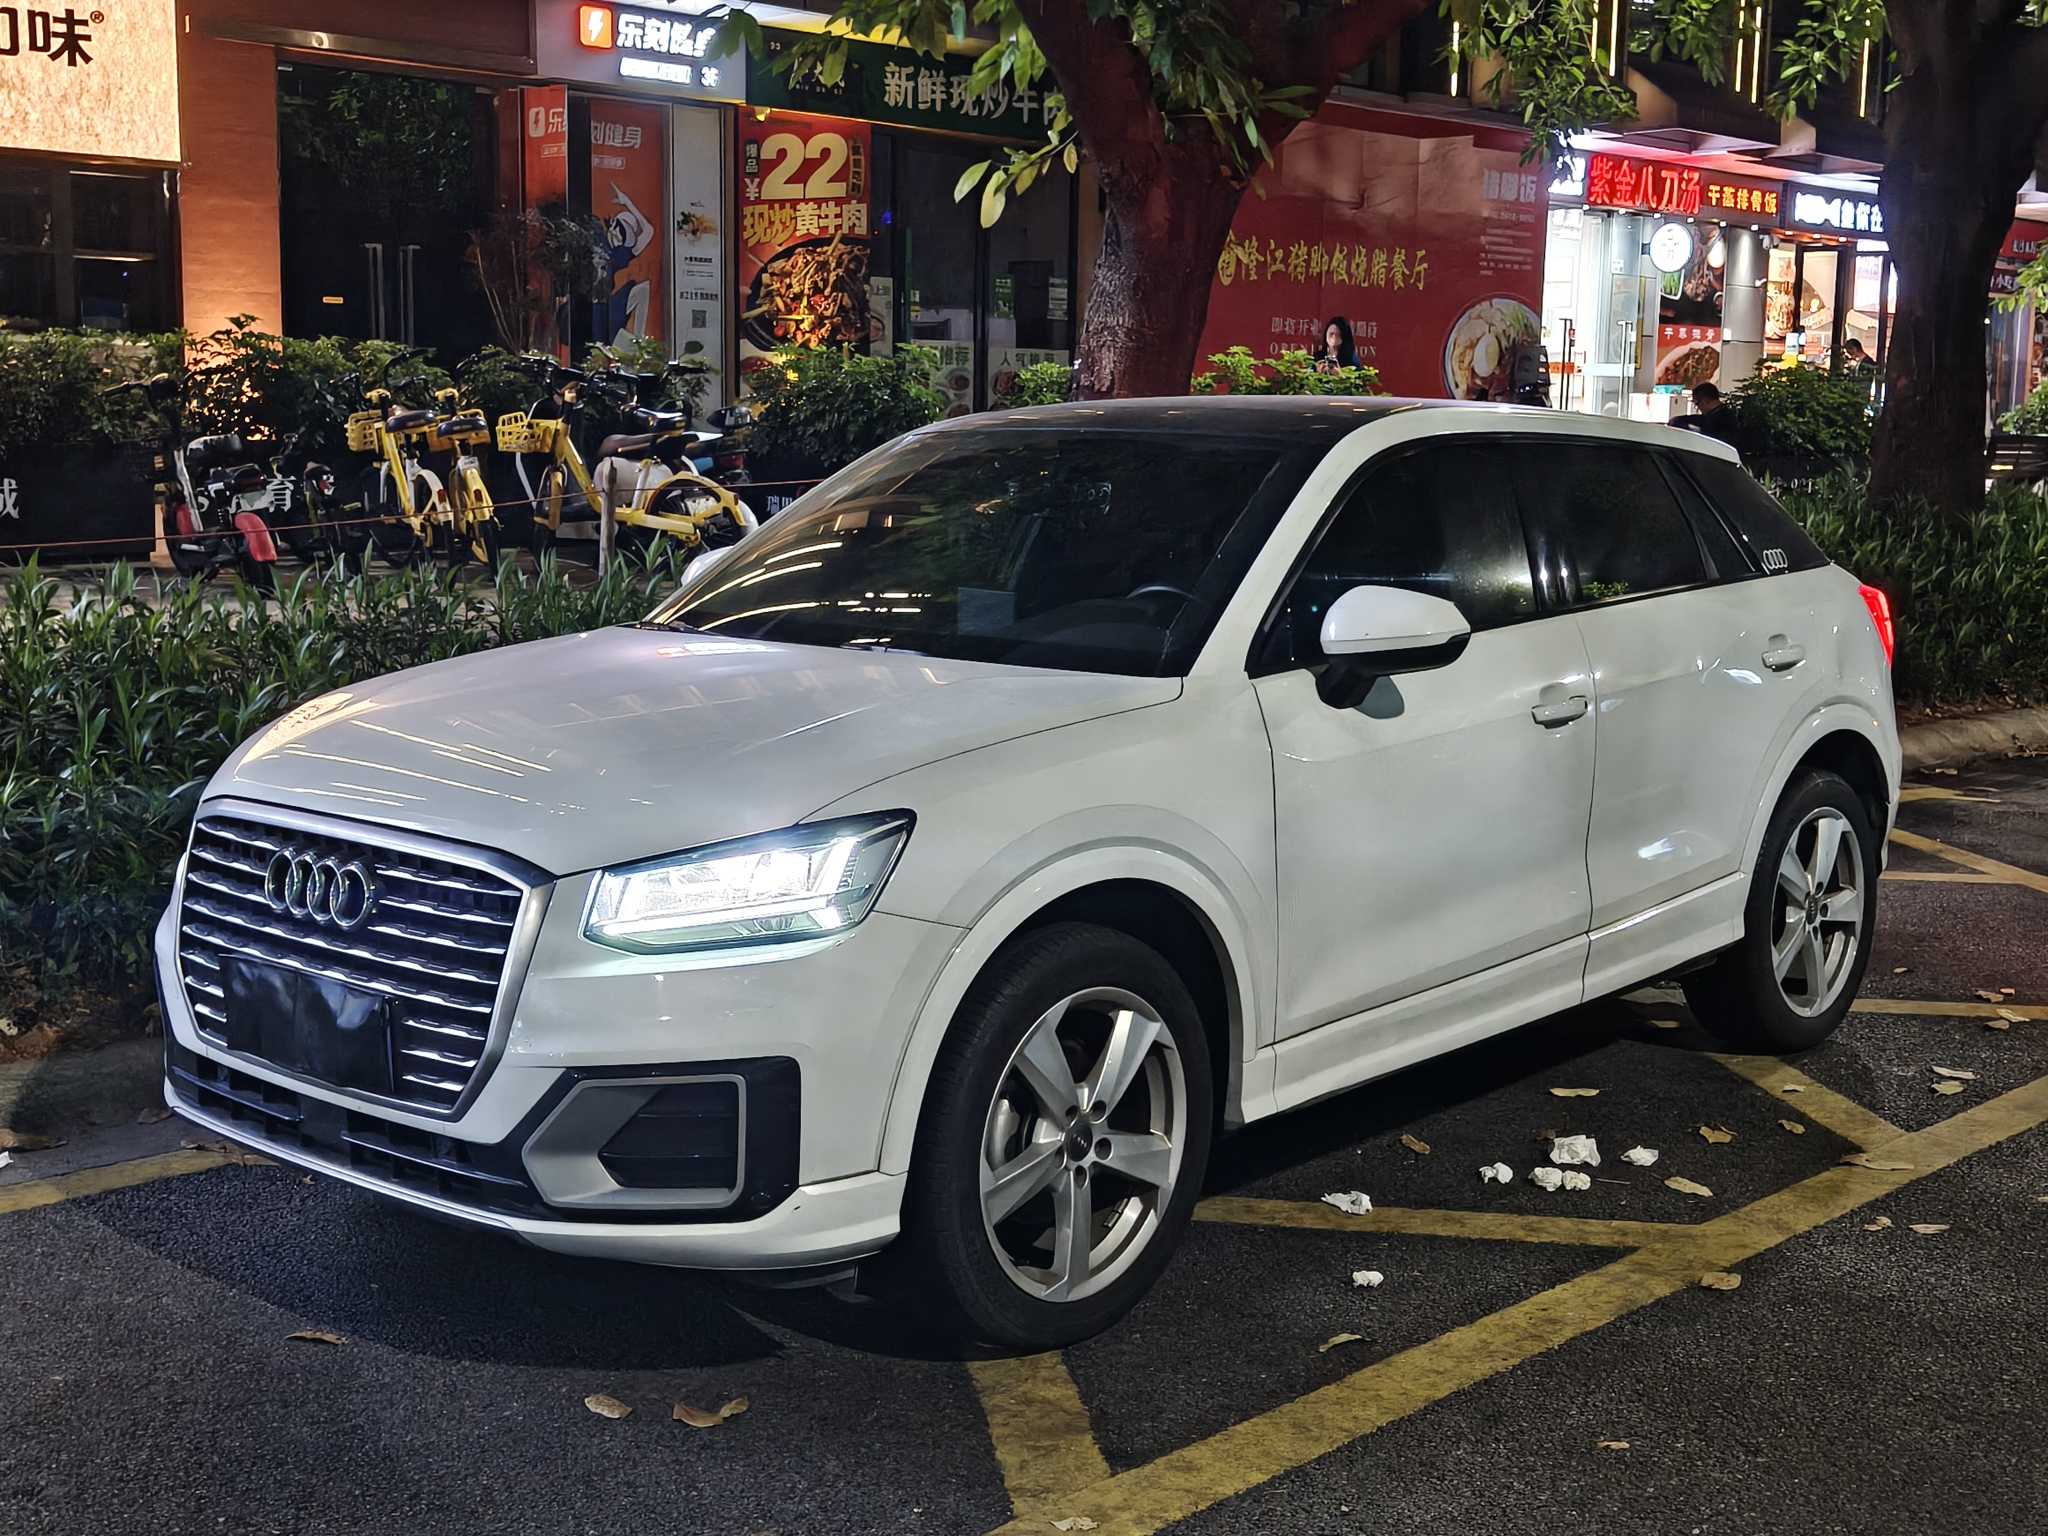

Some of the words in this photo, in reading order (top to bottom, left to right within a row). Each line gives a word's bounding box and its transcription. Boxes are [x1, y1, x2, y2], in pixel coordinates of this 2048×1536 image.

[1590, 155, 1700, 214] 紫金八刀汤
[1708, 184, 1777, 214] 干蒸排骨饭
[742, 200, 868, 247] 现炒黄牛肉
